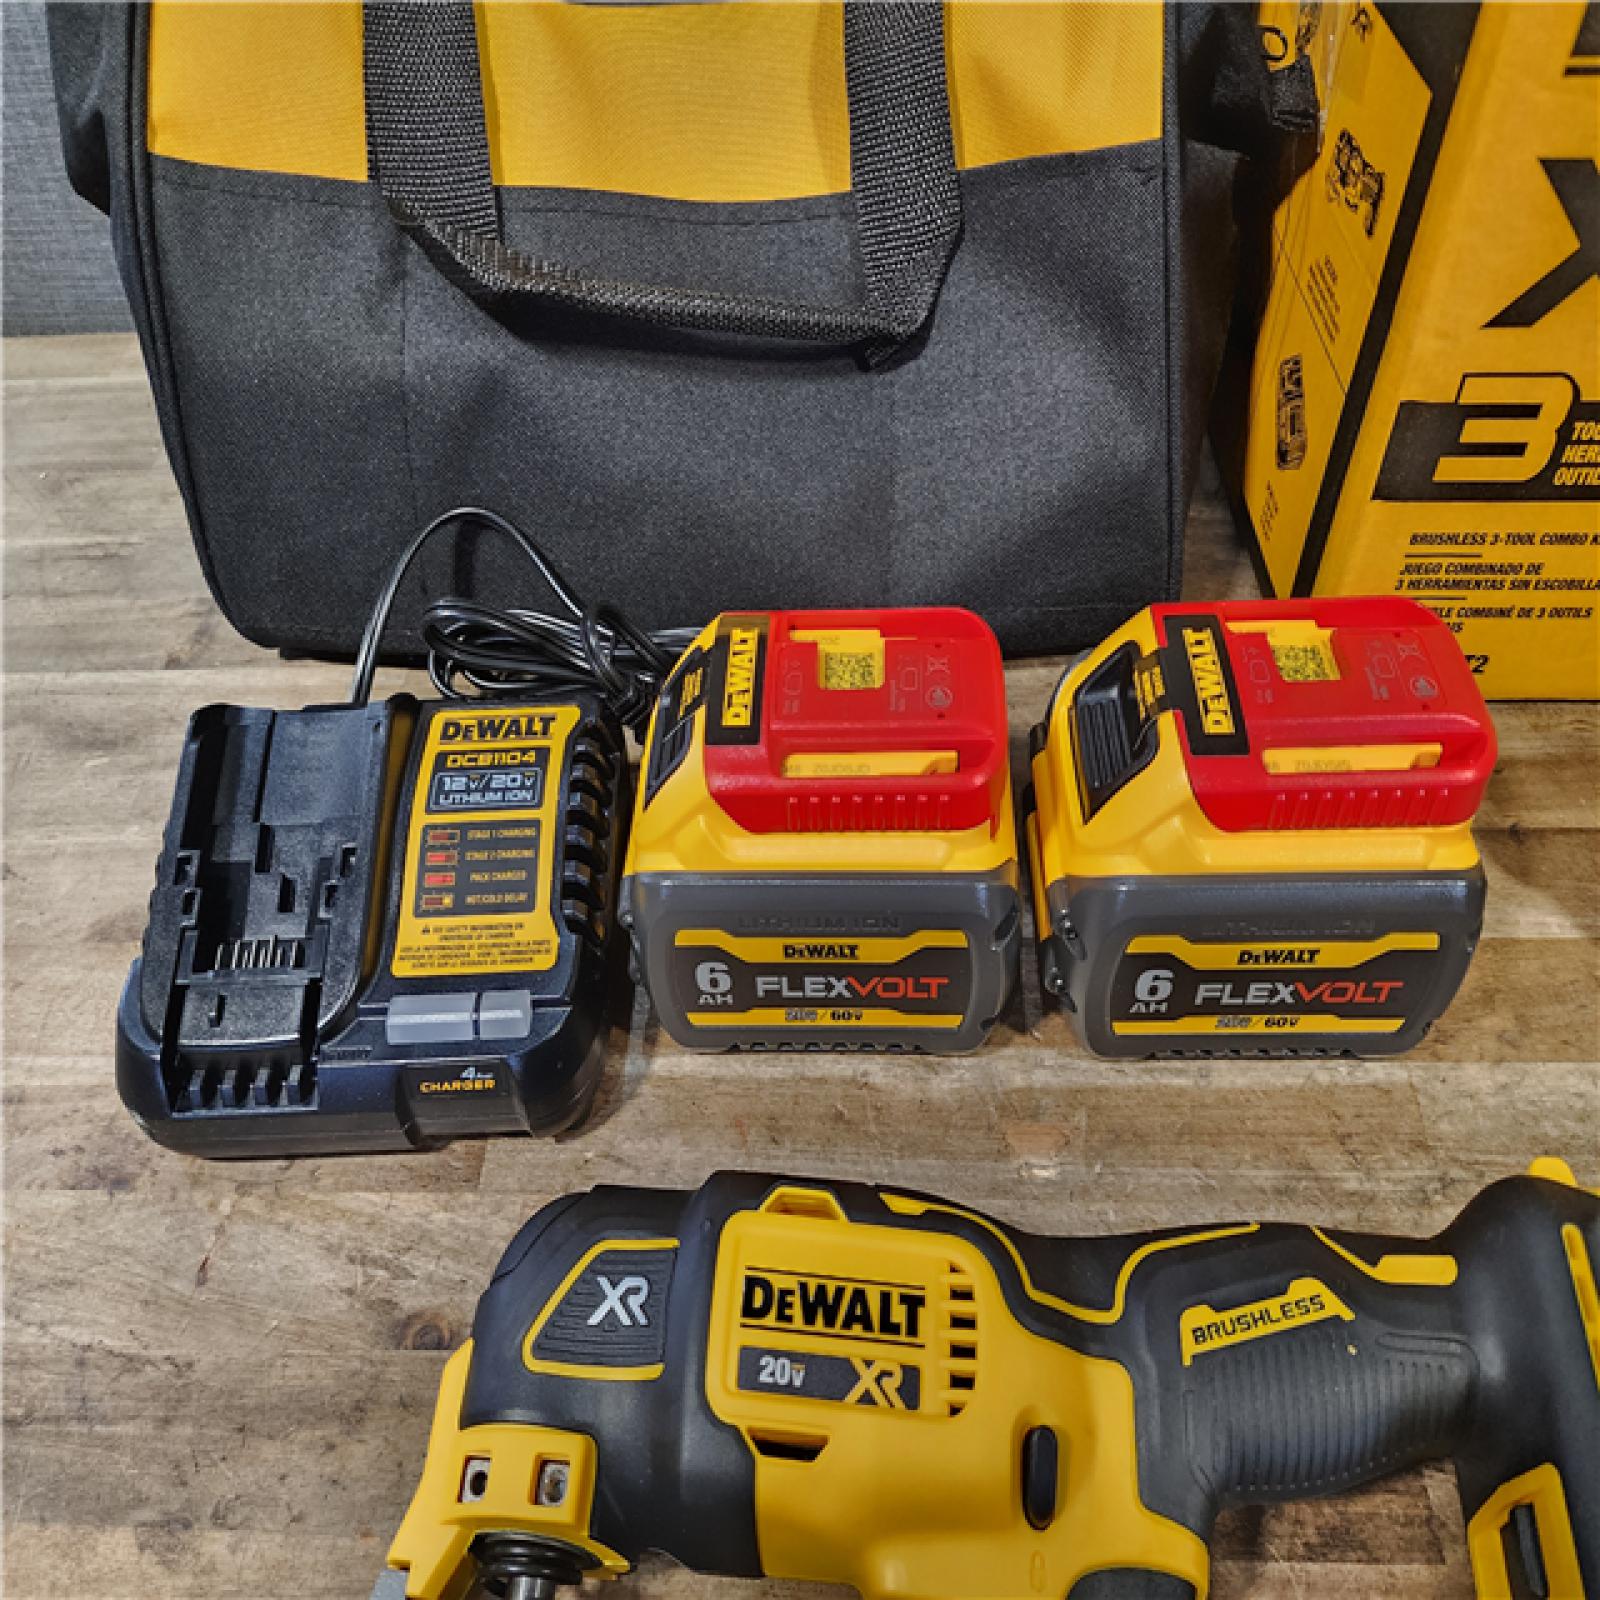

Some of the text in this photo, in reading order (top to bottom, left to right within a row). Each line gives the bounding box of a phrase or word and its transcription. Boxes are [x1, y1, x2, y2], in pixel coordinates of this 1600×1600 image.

[1431, 372, 1579, 483] 3
[1409, 532, 1487, 545] BRUSHLESS
[1540, 532, 1588, 545] COMBO
[1400, 562, 1545, 575] JUEGO COMBINADO DE
[1395, 579, 1403, 590] 3
[1407, 579, 1506, 590] HERRAMIENTAS
[1509, 579, 1532, 590] SIN
[1517, 607, 1534, 618] DE
[1548, 607, 1593, 618] OUTILS
[695, 961, 733, 994] 6
[755, 976, 949, 998] FLEXVOLT
[1135, 969, 1174, 1001] 6
[1194, 982, 1404, 1006] FLEXVOLT
[419, 1079, 497, 1094] CHARGER
[586, 1276, 651, 1327] XR
[1191, 1294, 1326, 1345] BRUSHLESS
[844, 1357, 906, 1409] XR
